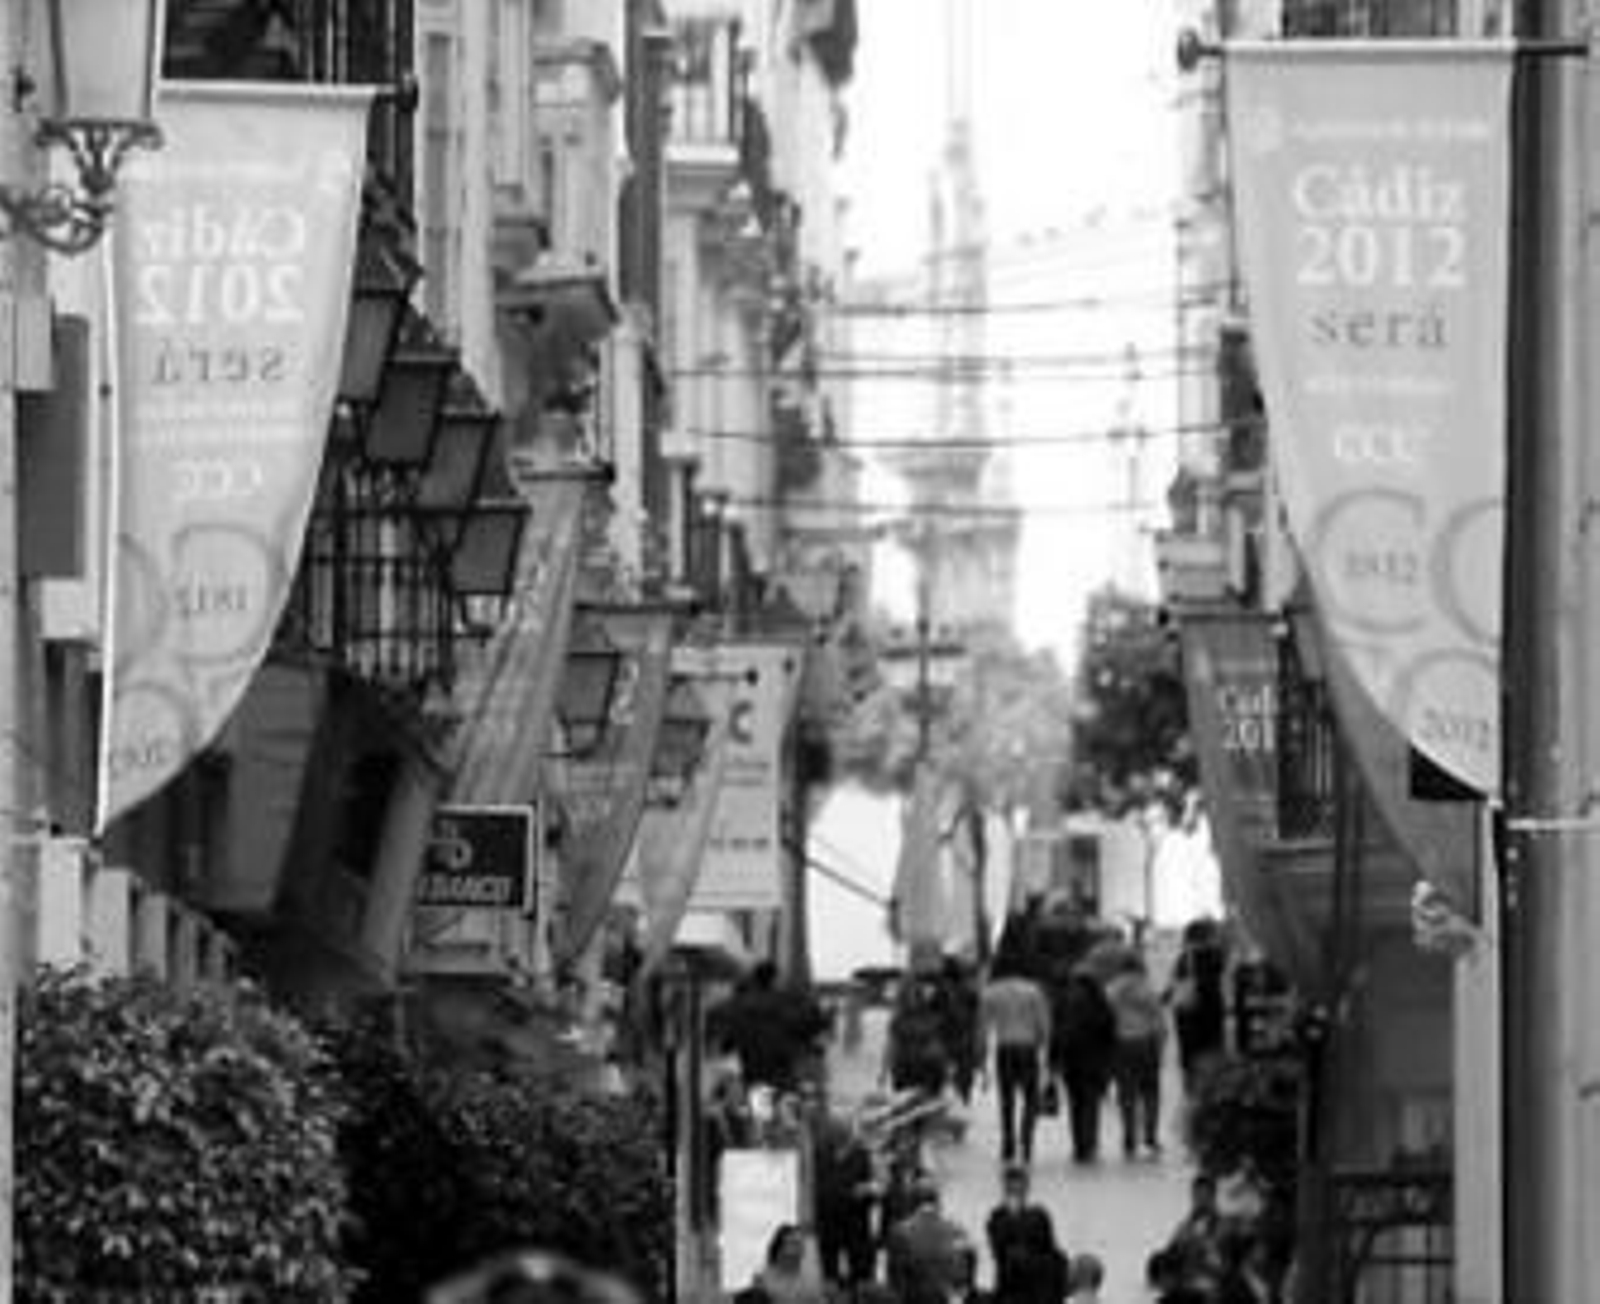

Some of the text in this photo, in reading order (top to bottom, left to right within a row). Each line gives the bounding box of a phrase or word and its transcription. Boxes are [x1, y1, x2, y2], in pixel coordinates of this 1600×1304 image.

[1293, 163, 1467, 222] Cádiz
[1296, 224, 1466, 287] 2012
[1310, 303, 1447, 348] será
